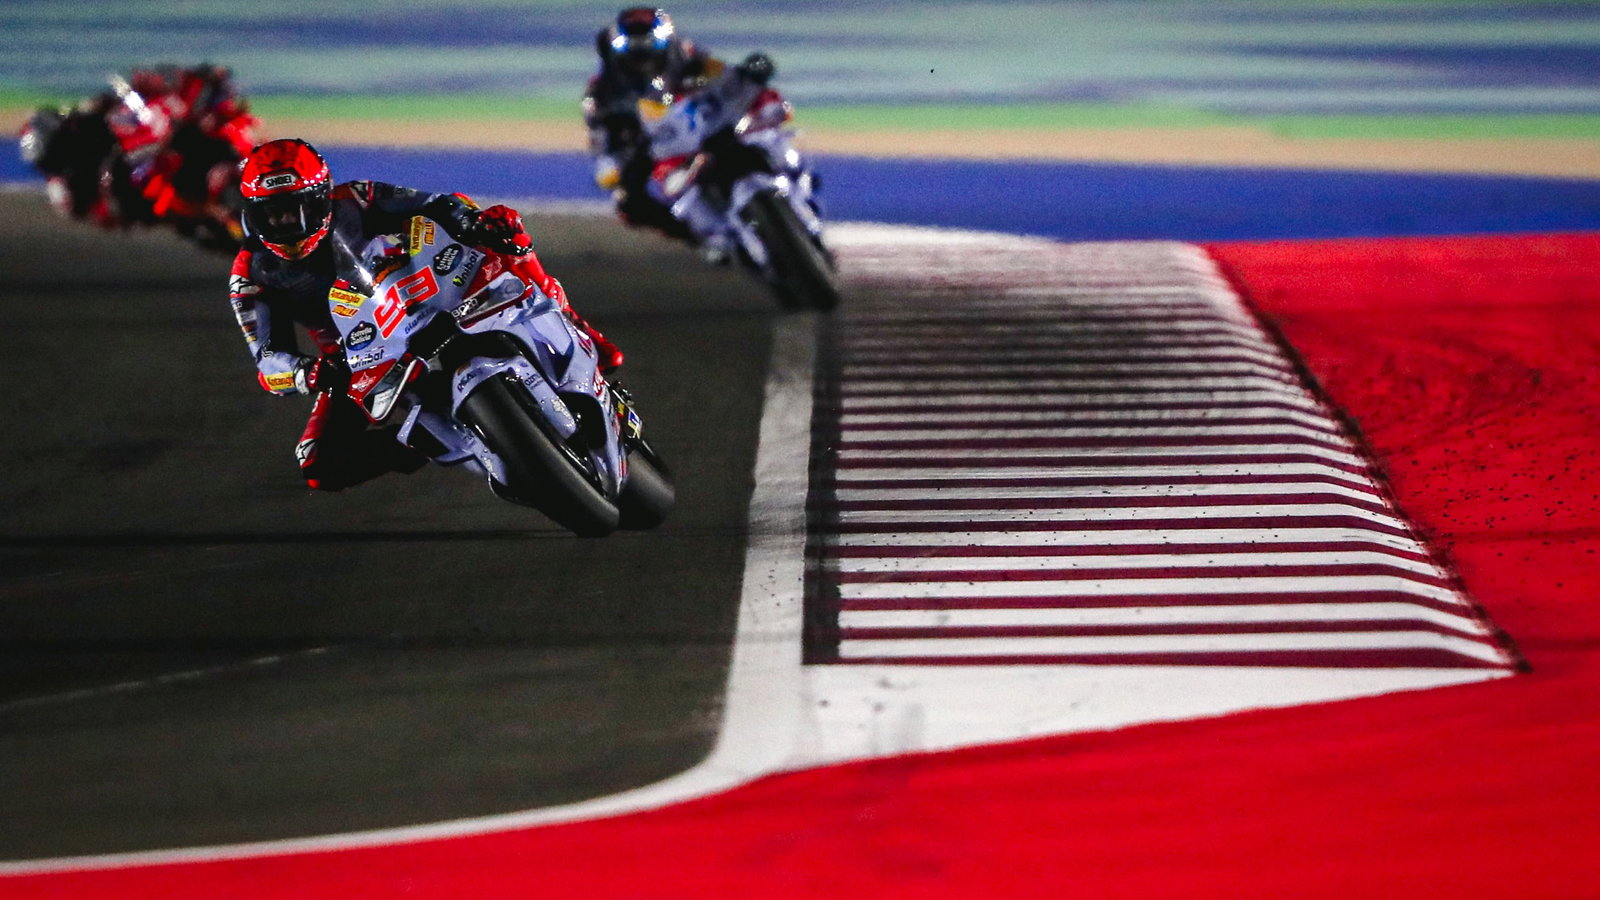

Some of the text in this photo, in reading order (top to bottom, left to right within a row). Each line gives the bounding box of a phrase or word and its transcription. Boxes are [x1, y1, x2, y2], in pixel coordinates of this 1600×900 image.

[266, 175, 292, 188] SHOEI
[453, 251, 479, 287] Unibat
[373, 265, 440, 340] 93
